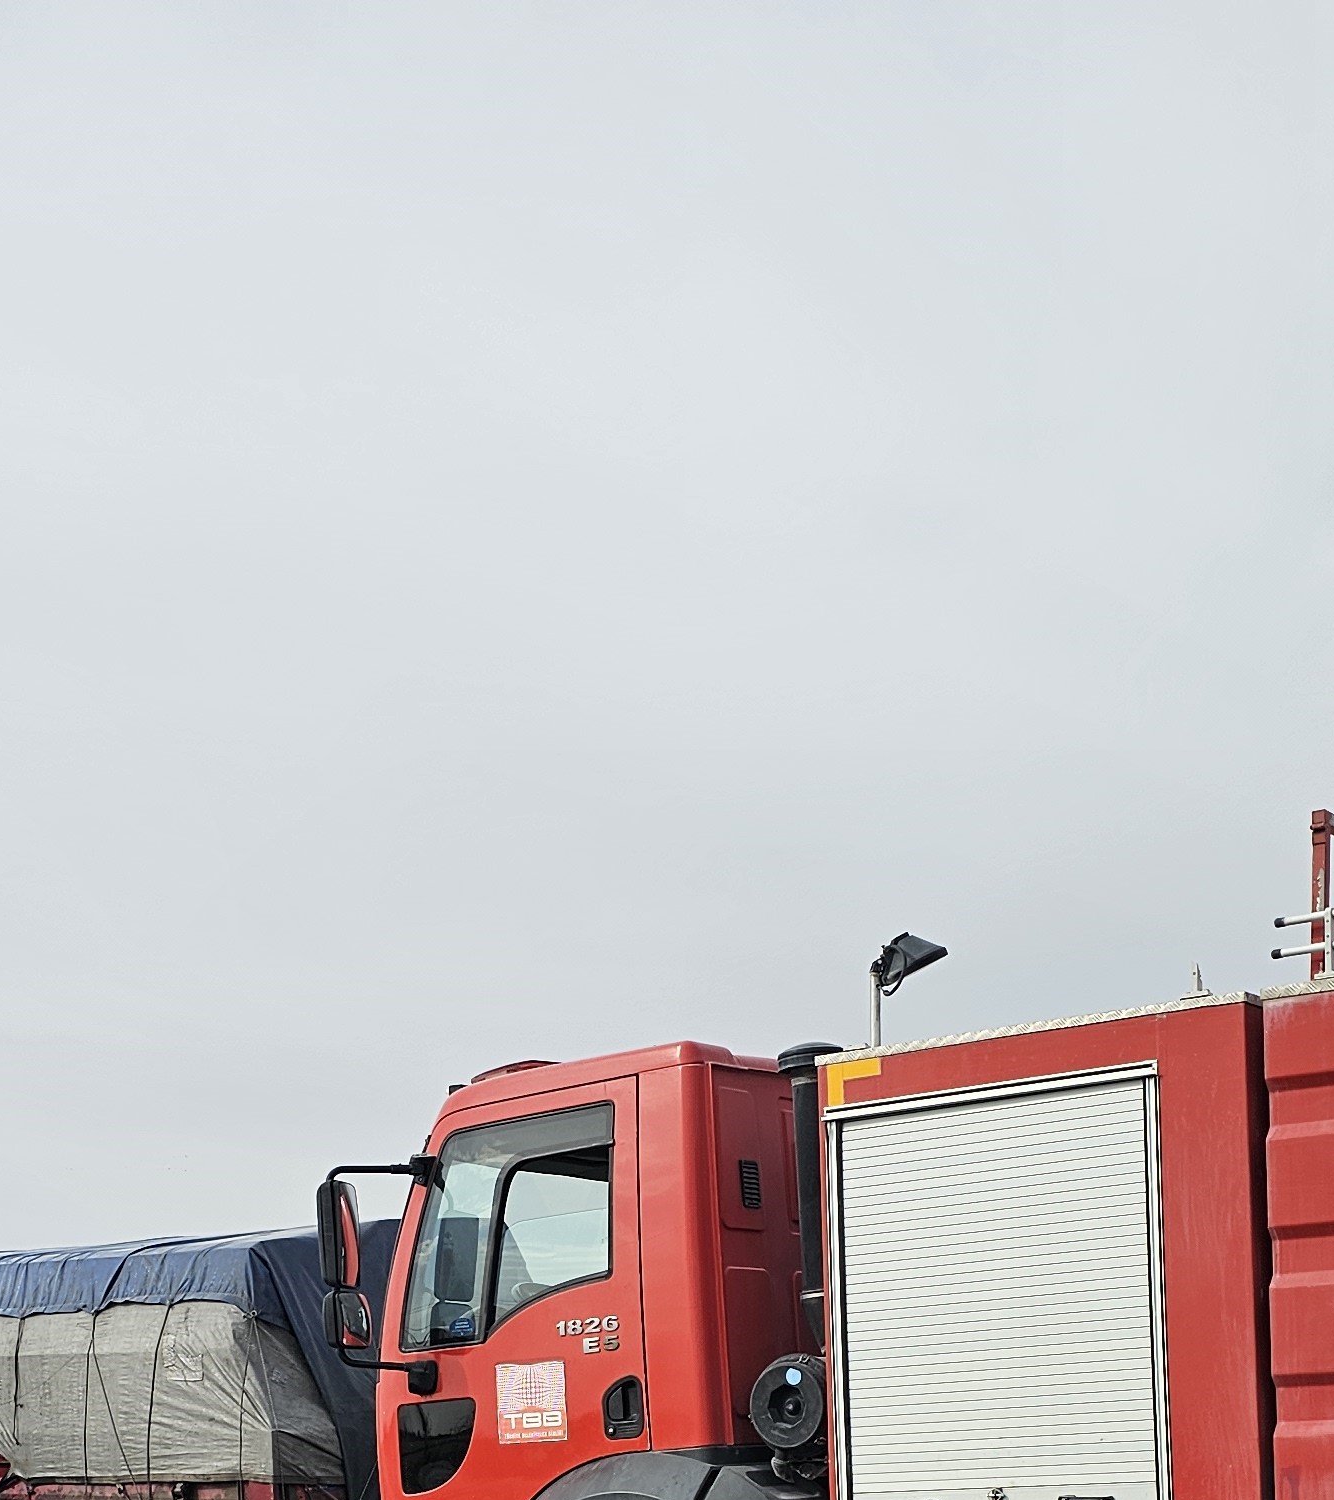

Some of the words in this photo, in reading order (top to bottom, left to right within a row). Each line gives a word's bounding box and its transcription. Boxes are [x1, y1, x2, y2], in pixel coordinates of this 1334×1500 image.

[556, 1315, 619, 1336] 1826
[582, 1335, 620, 1354] E5
[503, 1411, 563, 1429] TBB
